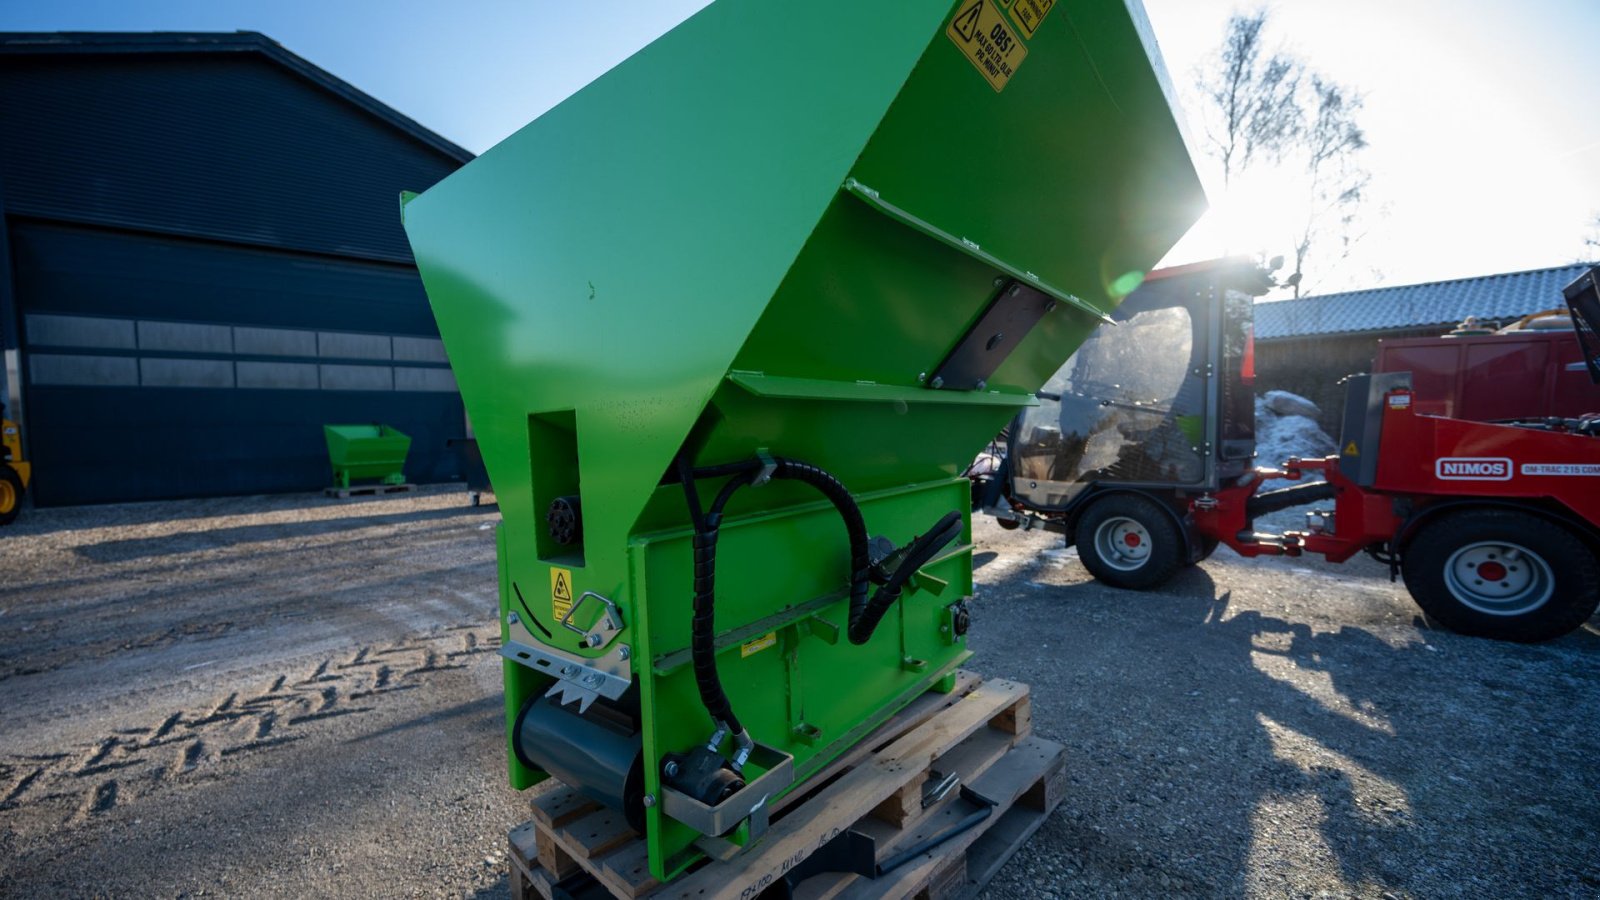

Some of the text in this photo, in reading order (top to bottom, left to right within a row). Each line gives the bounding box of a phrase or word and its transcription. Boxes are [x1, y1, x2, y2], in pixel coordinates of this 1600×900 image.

[974, 29, 988, 48] MAX
[983, 57, 1000, 78] MINUT
[1443, 462, 1504, 475] NIMOS
[1563, 465, 1580, 473] 215
